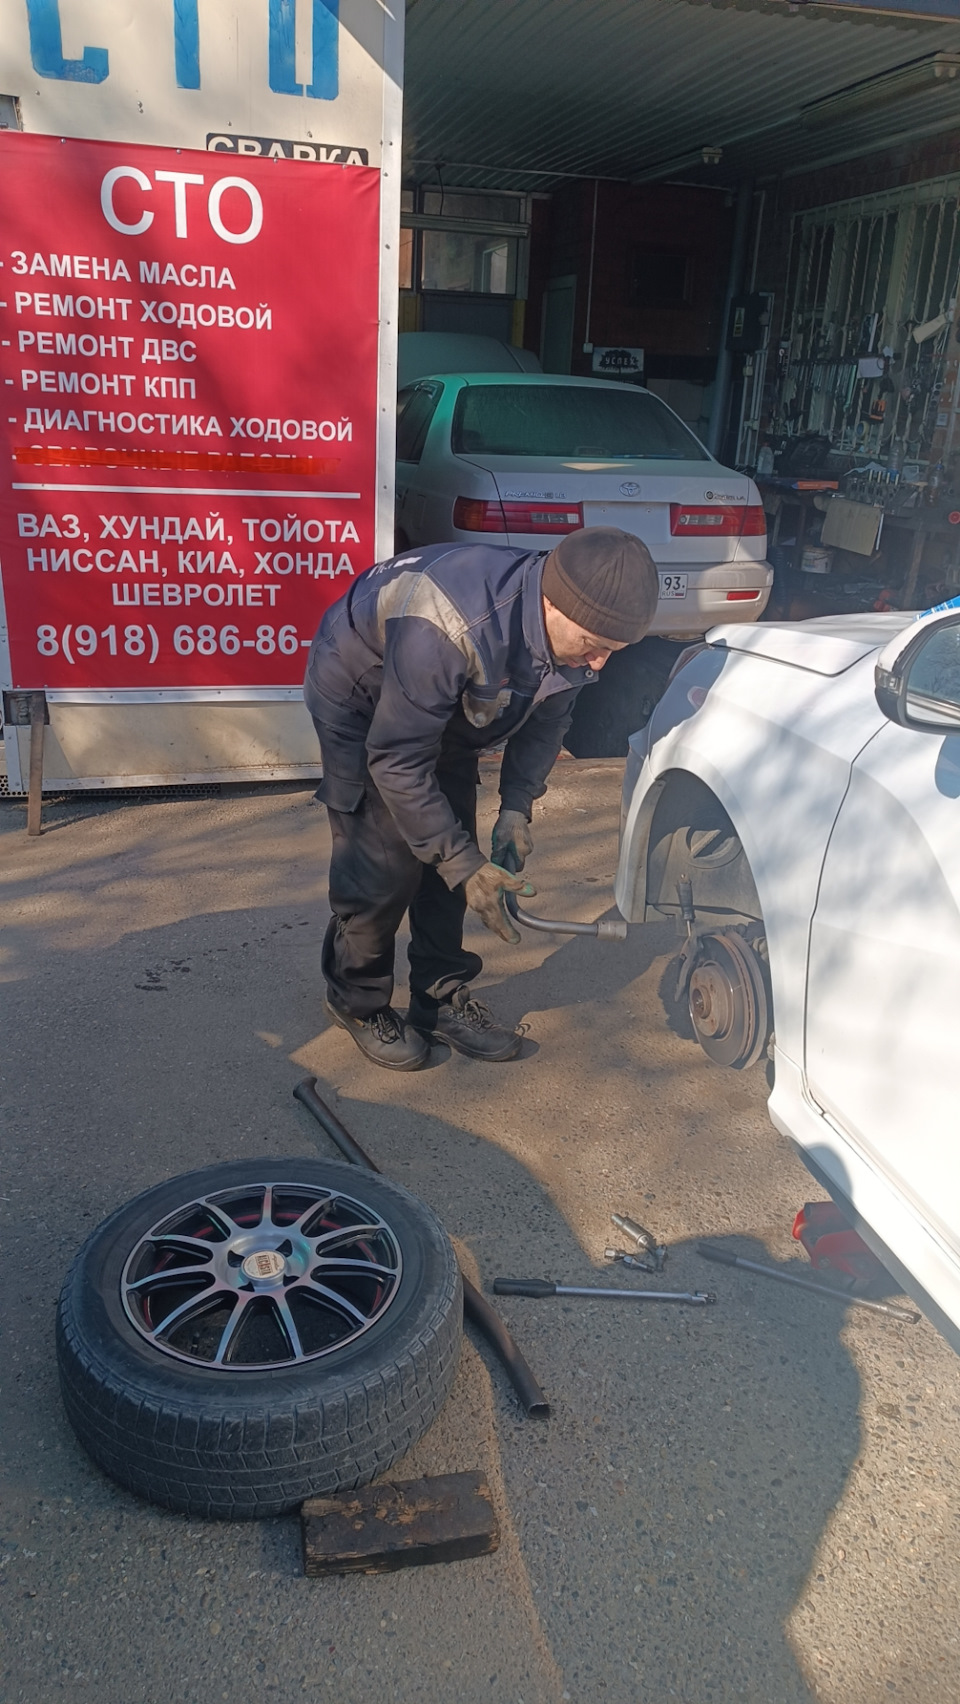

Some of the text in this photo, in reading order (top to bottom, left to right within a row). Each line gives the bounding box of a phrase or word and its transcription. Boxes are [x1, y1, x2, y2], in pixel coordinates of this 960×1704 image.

[100, 166, 264, 244] СТО
[10, 251, 236, 290] ЗАМЕНА МАСЛА
[14, 291, 133, 321] РЕМОНТ
[140, 301, 272, 330] ХОДОВОЙ
[18, 330, 134, 359] РЕМОНТ
[141, 338, 197, 365] ДВС
[21, 369, 136, 397] РЕМОНТ
[144, 376, 196, 400] КПП
[24, 407, 223, 437] ДИАГНОСТИКА
[229, 417, 353, 442] ХОДОВОЙ
[17, 511, 360, 546] ВАЗ, ХУНДАЙ, ТОЙОТА
[26, 547, 168, 578] НИССАН,
[177, 550, 245, 579] КИА,
[253, 552, 355, 580] ХОНДА
[111, 583, 281, 607] ШЕВРОЛЕТ
[664, 576, 681, 591] 93
[36, 624, 313, 665] 8(918) 686-86-
